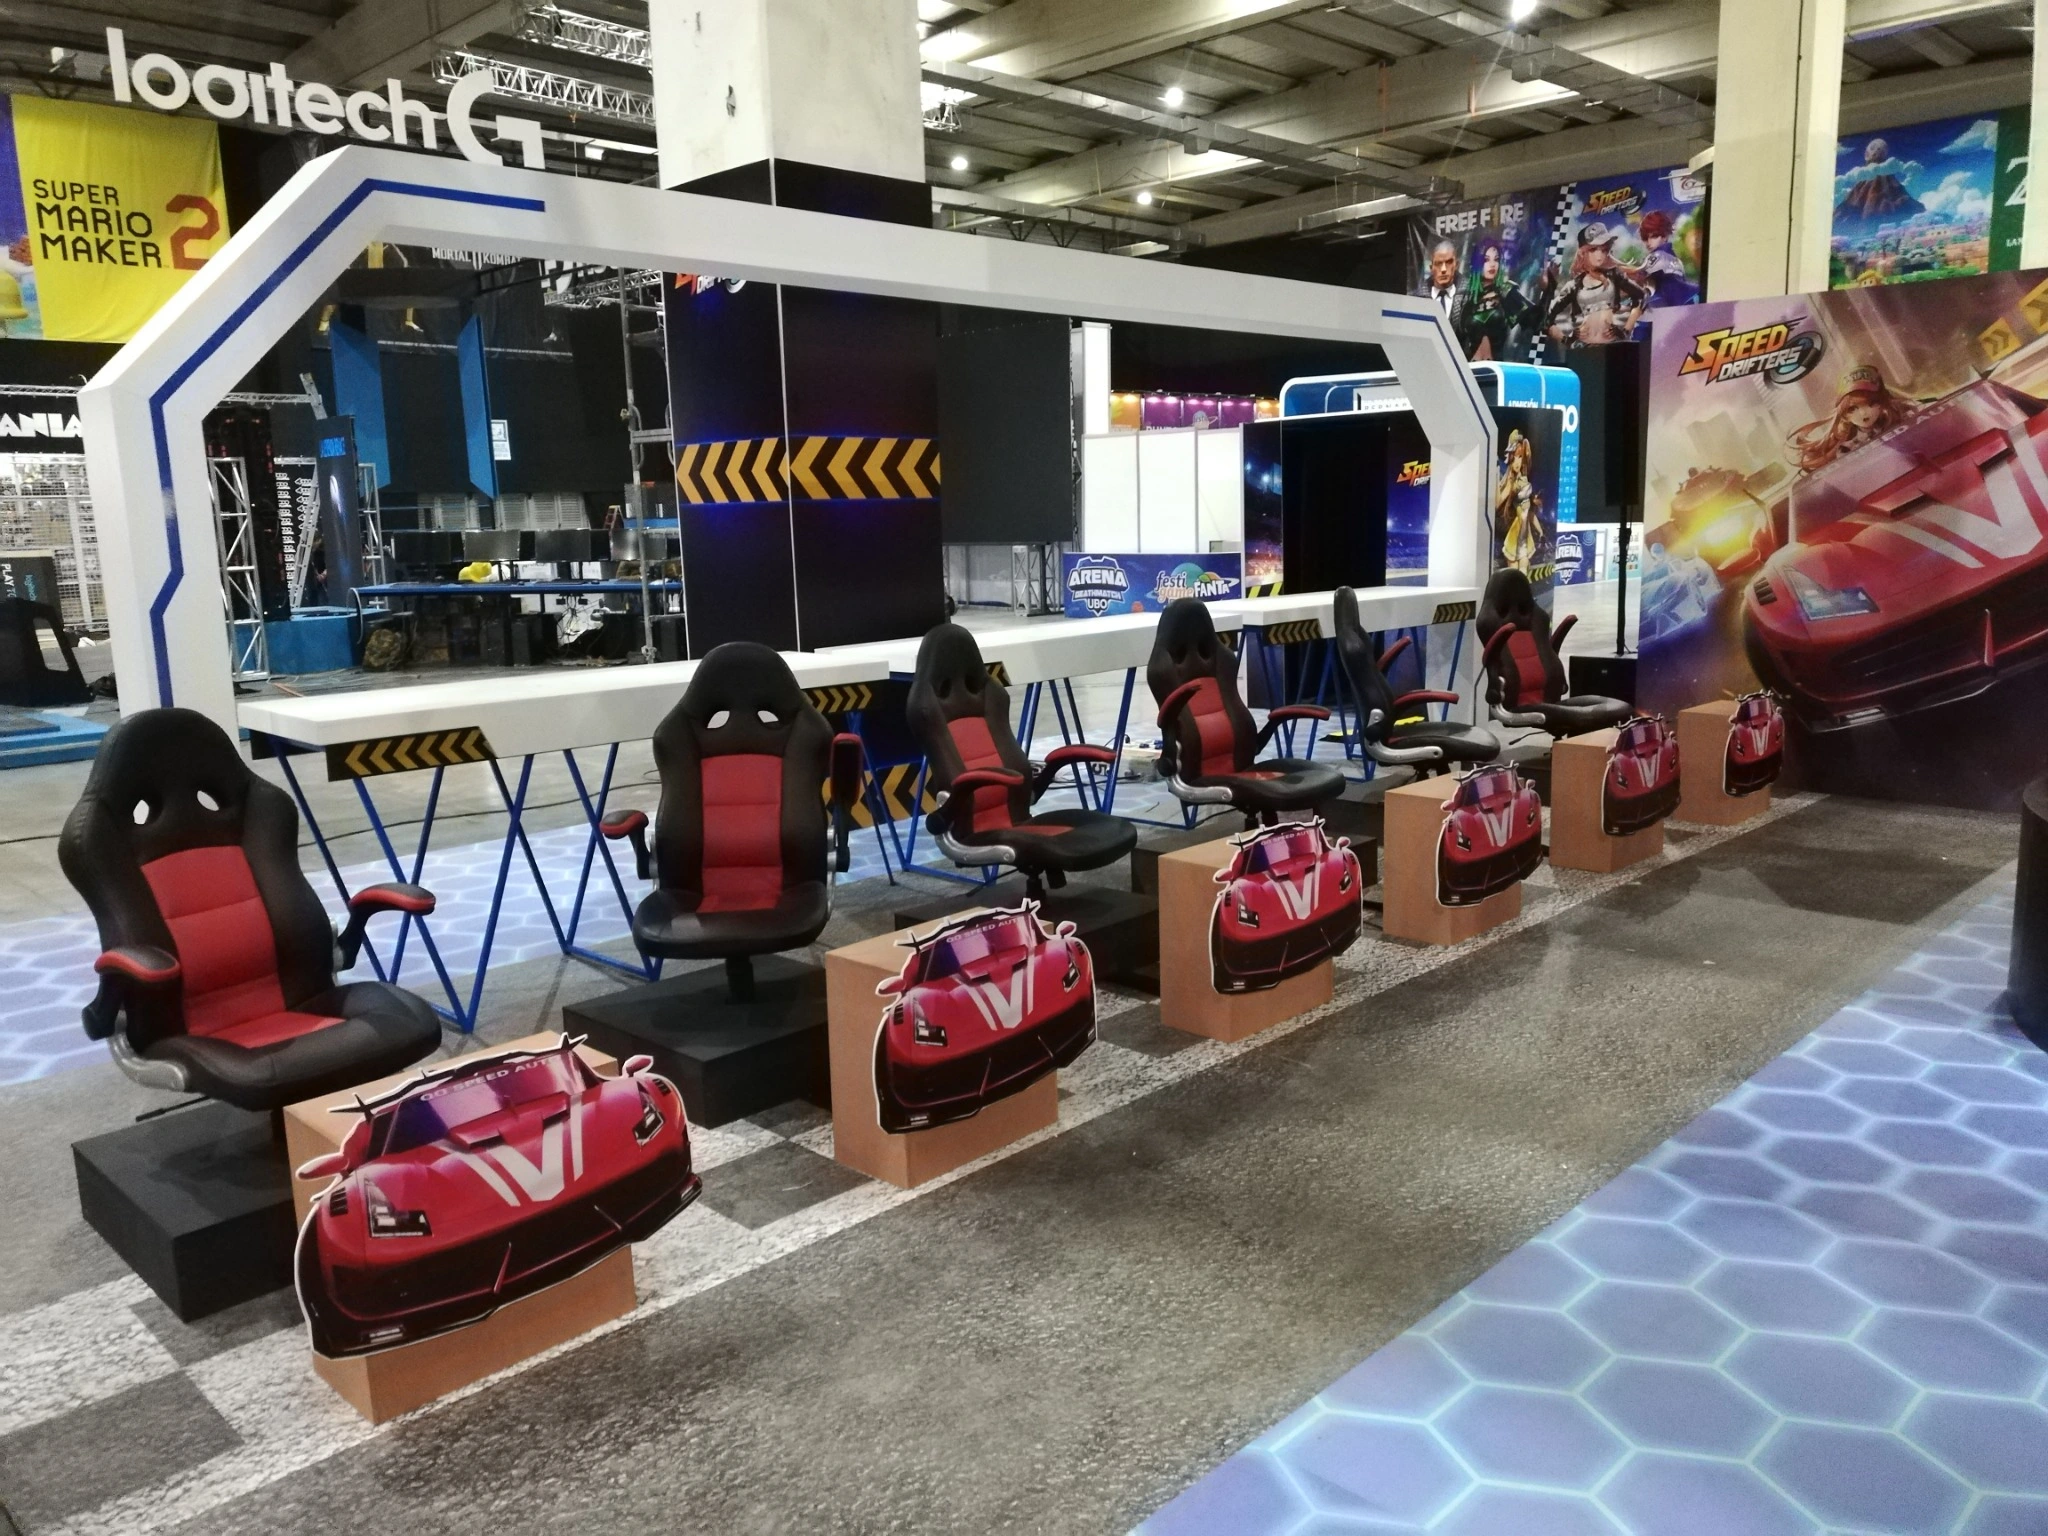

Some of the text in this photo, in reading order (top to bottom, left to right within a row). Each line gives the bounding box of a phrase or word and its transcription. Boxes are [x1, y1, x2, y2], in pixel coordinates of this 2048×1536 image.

[33, 179, 120, 206] SUPER
[1582, 186, 1632, 215] SPEED
[36, 202, 152, 238] MARIO
[40, 194, 221, 271] MAKER 2
[1435, 210, 1477, 236] FREE
[432, 247, 472, 262] MORTAL
[1678, 324, 1790, 385] SPEED
[1717, 345, 1802, 382] DRIFTERS
[1069, 569, 1127, 588] ARENA
[1156, 570, 1187, 592] festi
[1074, 589, 1122, 600] DEATHMATCH
[1158, 579, 1230, 604] game FANTA
[1088, 600, 1108, 610] UBO
[964, 924, 996, 937] SPEED
[453, 1069, 510, 1092] SPEED
